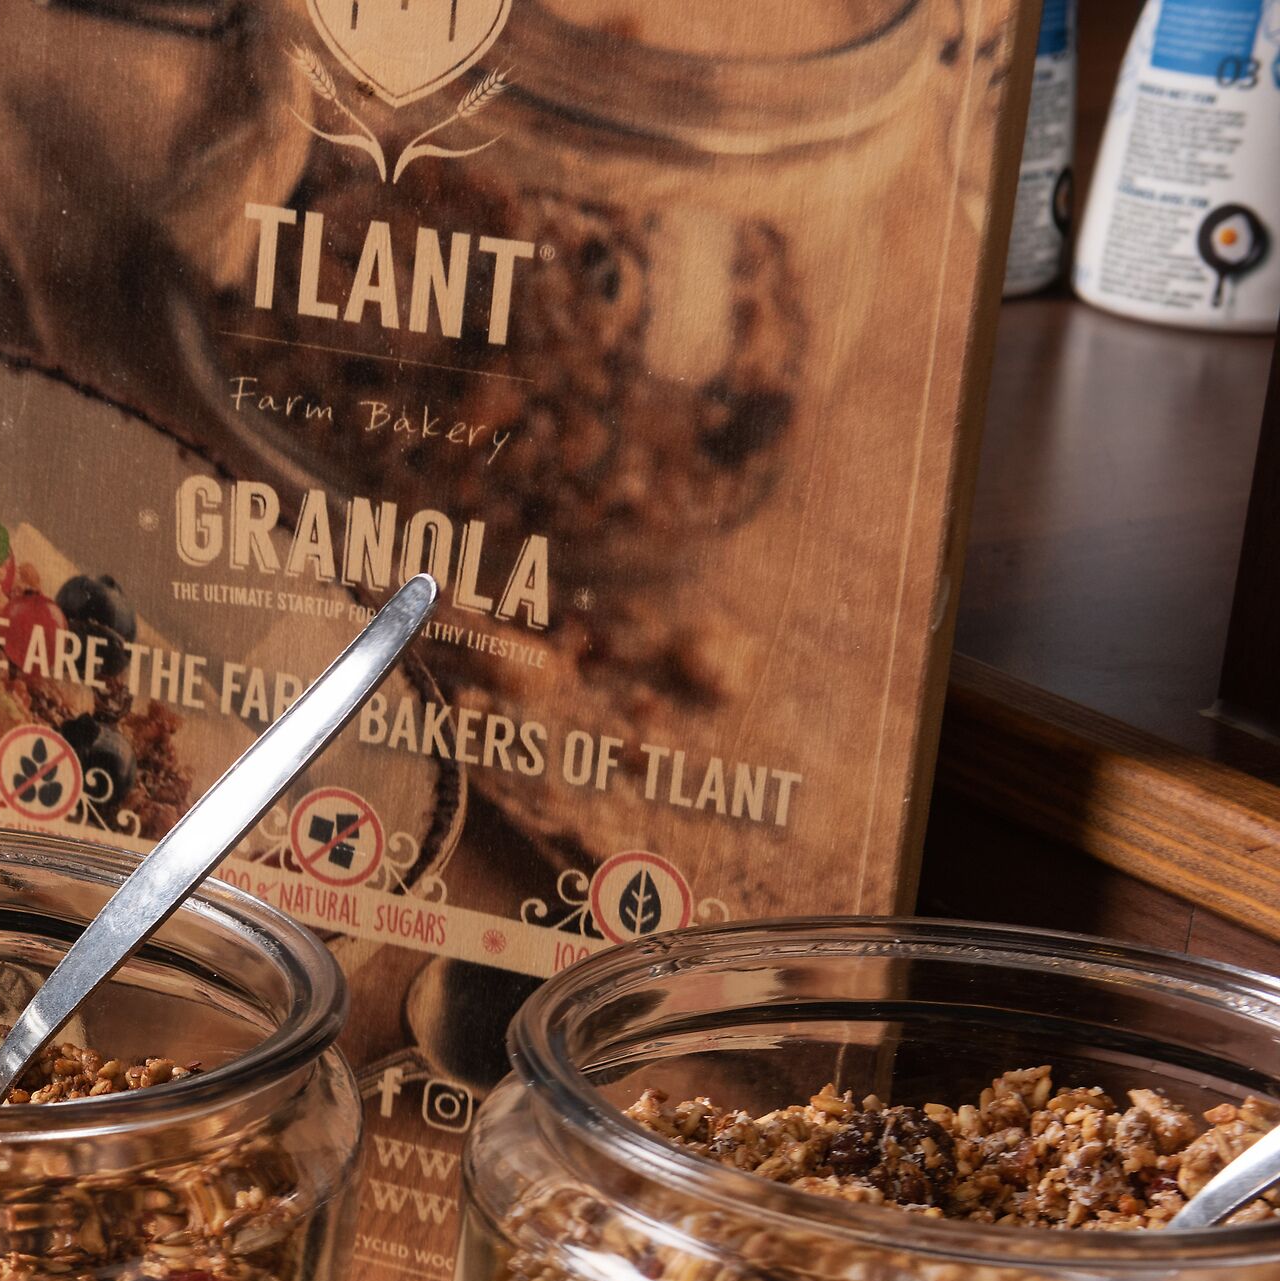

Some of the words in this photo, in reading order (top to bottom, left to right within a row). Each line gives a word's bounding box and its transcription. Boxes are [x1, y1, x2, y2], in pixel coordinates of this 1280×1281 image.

[230, 376, 333, 421] Farm
[359, 400, 510, 465] Bakery
[175, 474, 549, 630] GRANOLA
[172, 581, 199, 601] THE
[203, 585, 274, 610] ULTIMATE
[276, 593, 345, 620] STARTUP
[467, 629, 549, 669] LIFESTYLE
[23, 624, 108, 691] ARE
[124, 641, 206, 710] THE
[220, 661, 314, 723] FAR
[358, 692, 548, 777] BAKERS
[562, 730, 624, 791] OF
[640, 742, 803, 826] TLANT
[279, 880, 361, 929] NATURAL
[374, 904, 447, 947] SUGARS
[415, 1249, 454, 1272] WOO
